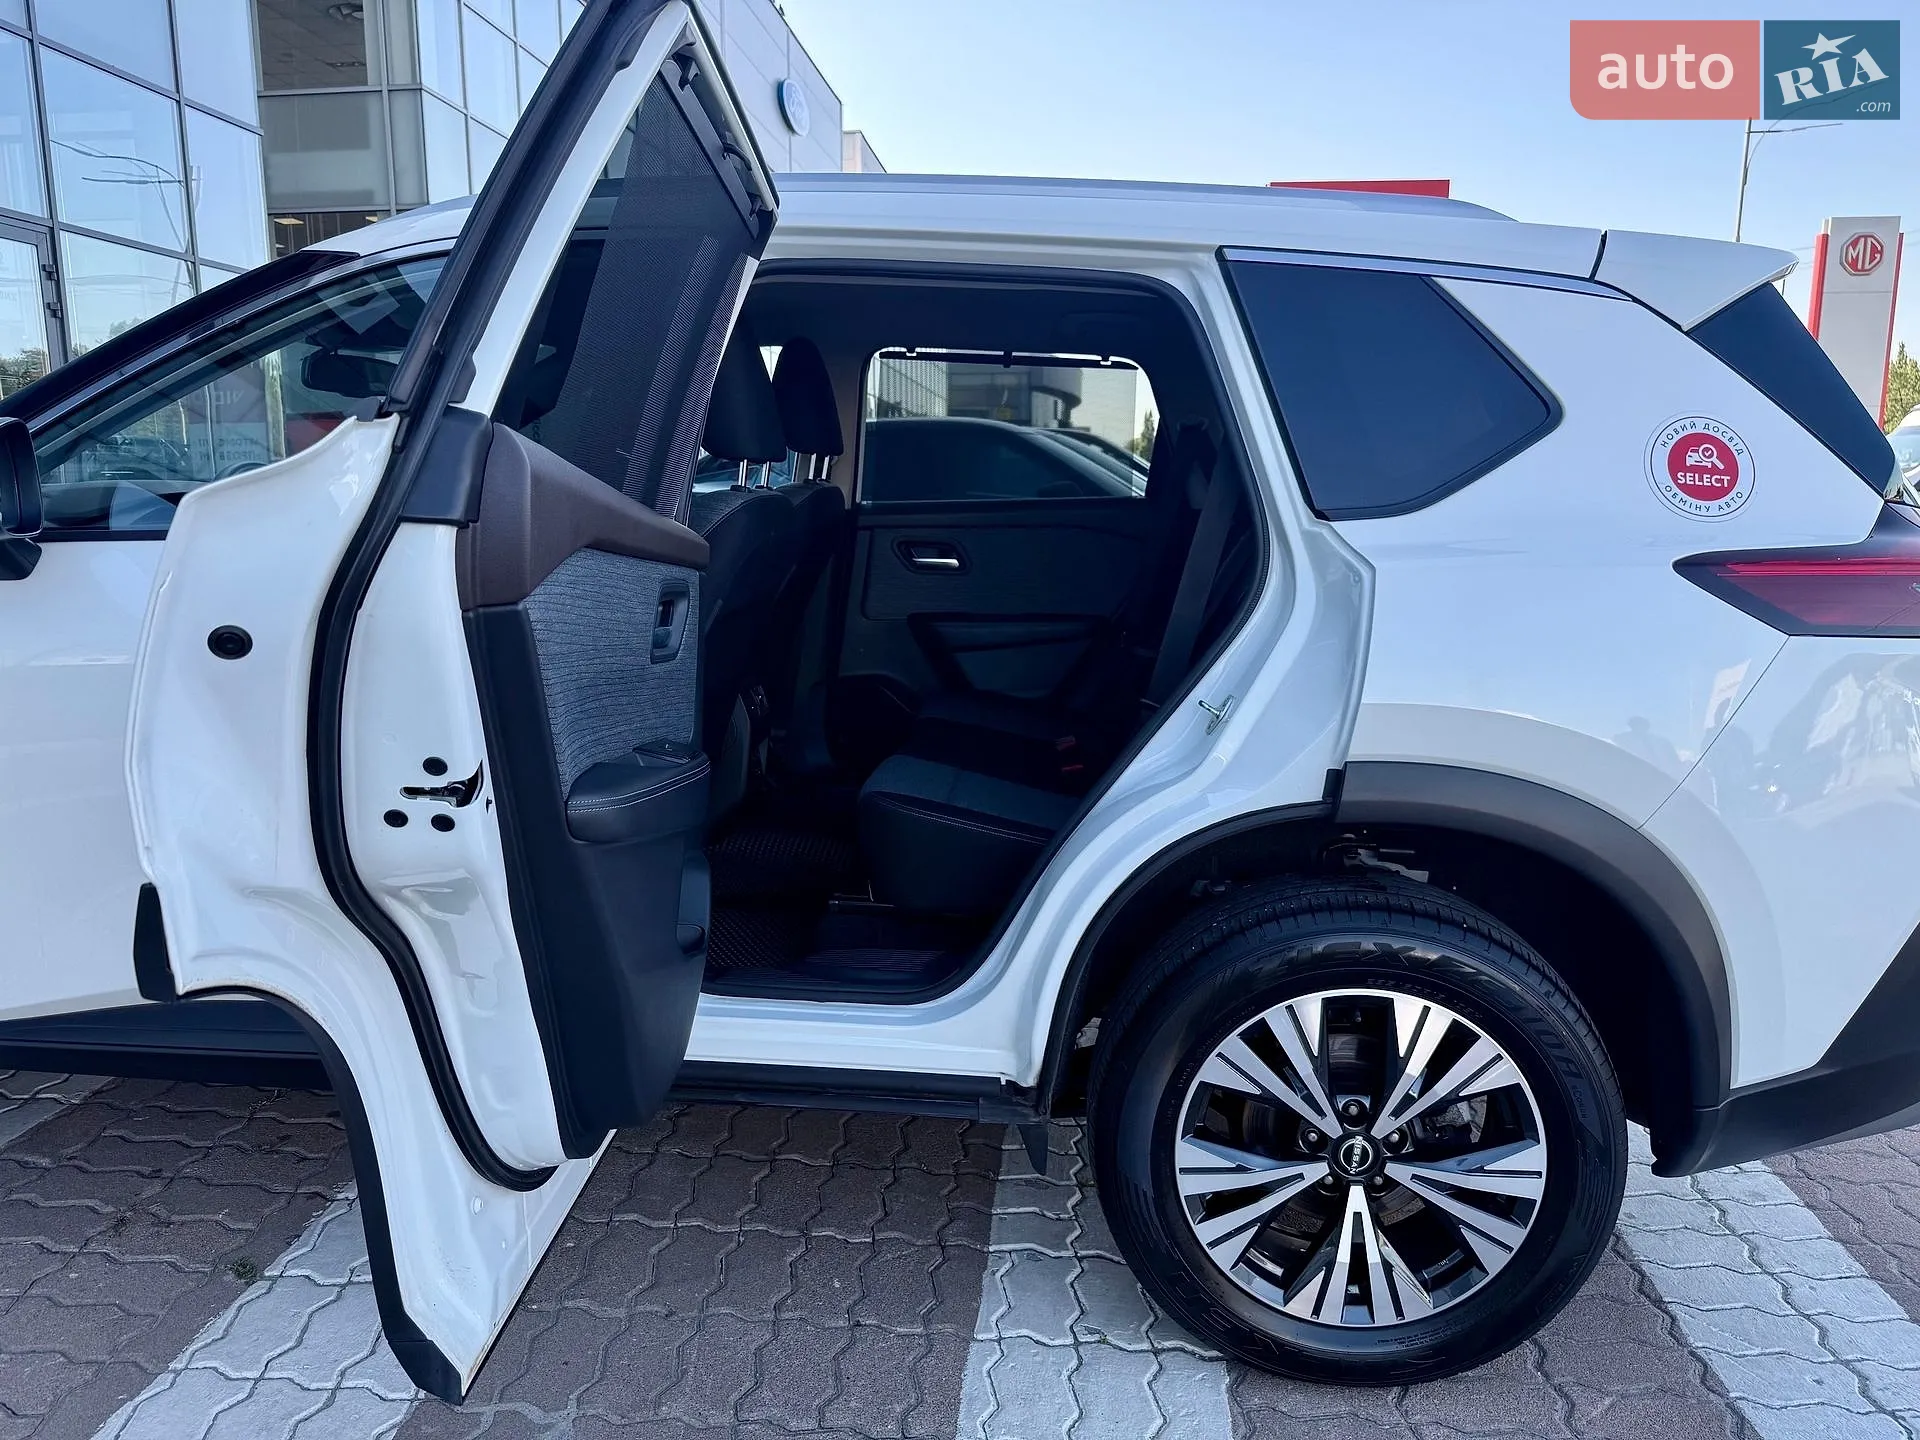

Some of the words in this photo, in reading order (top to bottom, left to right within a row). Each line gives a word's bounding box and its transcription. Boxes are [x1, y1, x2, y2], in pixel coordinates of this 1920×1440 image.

[1847, 237, 1882, 270] MG
[1660, 420, 1697, 448] НОВИЙ
[1703, 423, 1745, 456] ДОСВІД
[1677, 472, 1731, 488] SELECT
[1664, 485, 1711, 513] ОБМІНУ
[1718, 491, 1744, 512] АВТО
[1349, 1135, 1364, 1175] NISSAN
